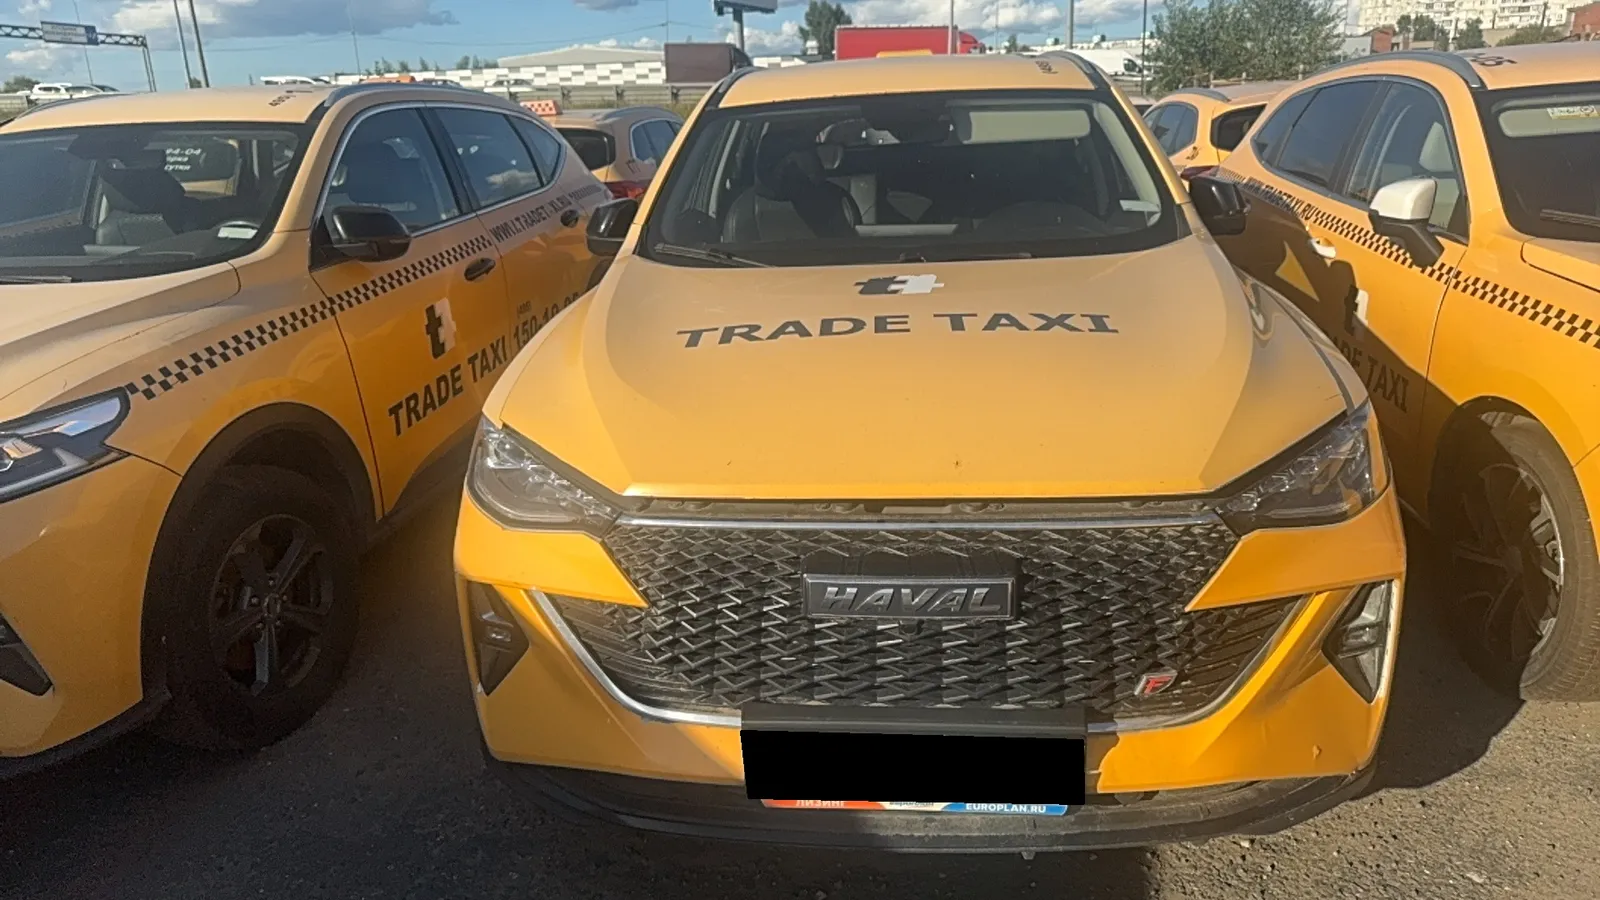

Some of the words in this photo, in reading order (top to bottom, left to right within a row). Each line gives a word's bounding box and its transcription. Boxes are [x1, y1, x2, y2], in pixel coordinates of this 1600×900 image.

[677, 314, 911, 348] TRADE
[933, 312, 1120, 334] TAXI
[388, 363, 464, 437] TRADE
[467, 335, 508, 383] TAXI
[1366, 355, 1409, 414] TAXI
[820, 586, 1001, 613] HAVAL
[965, 803, 1047, 813] EUROPLAN.RU
